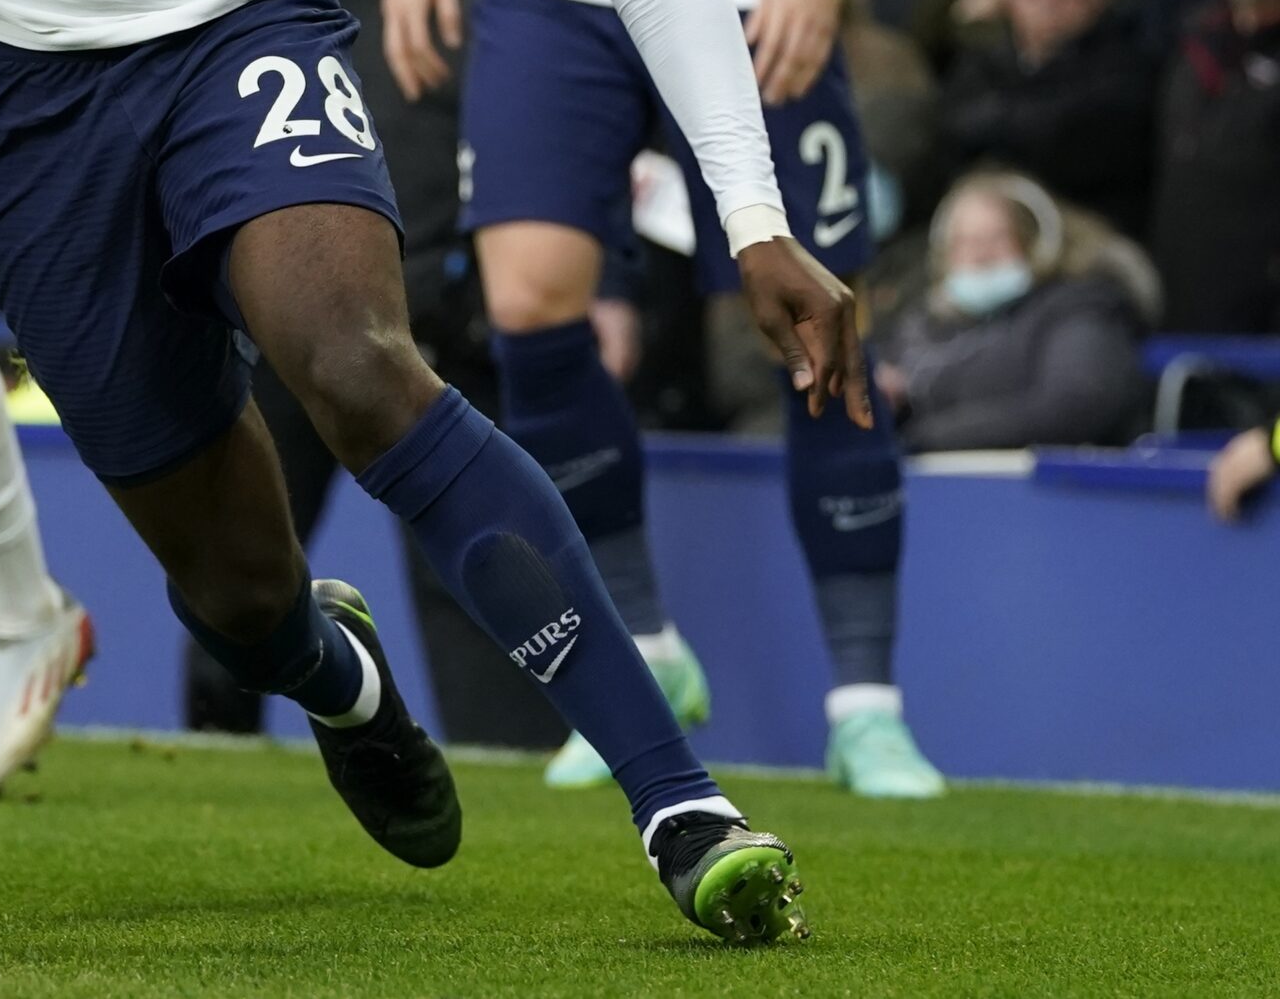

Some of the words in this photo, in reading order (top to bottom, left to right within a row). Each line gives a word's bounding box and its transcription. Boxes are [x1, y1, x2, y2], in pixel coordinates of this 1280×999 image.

[238, 55, 376, 151] 28
[799, 120, 858, 217] 2
[509, 607, 582, 669] PURS
